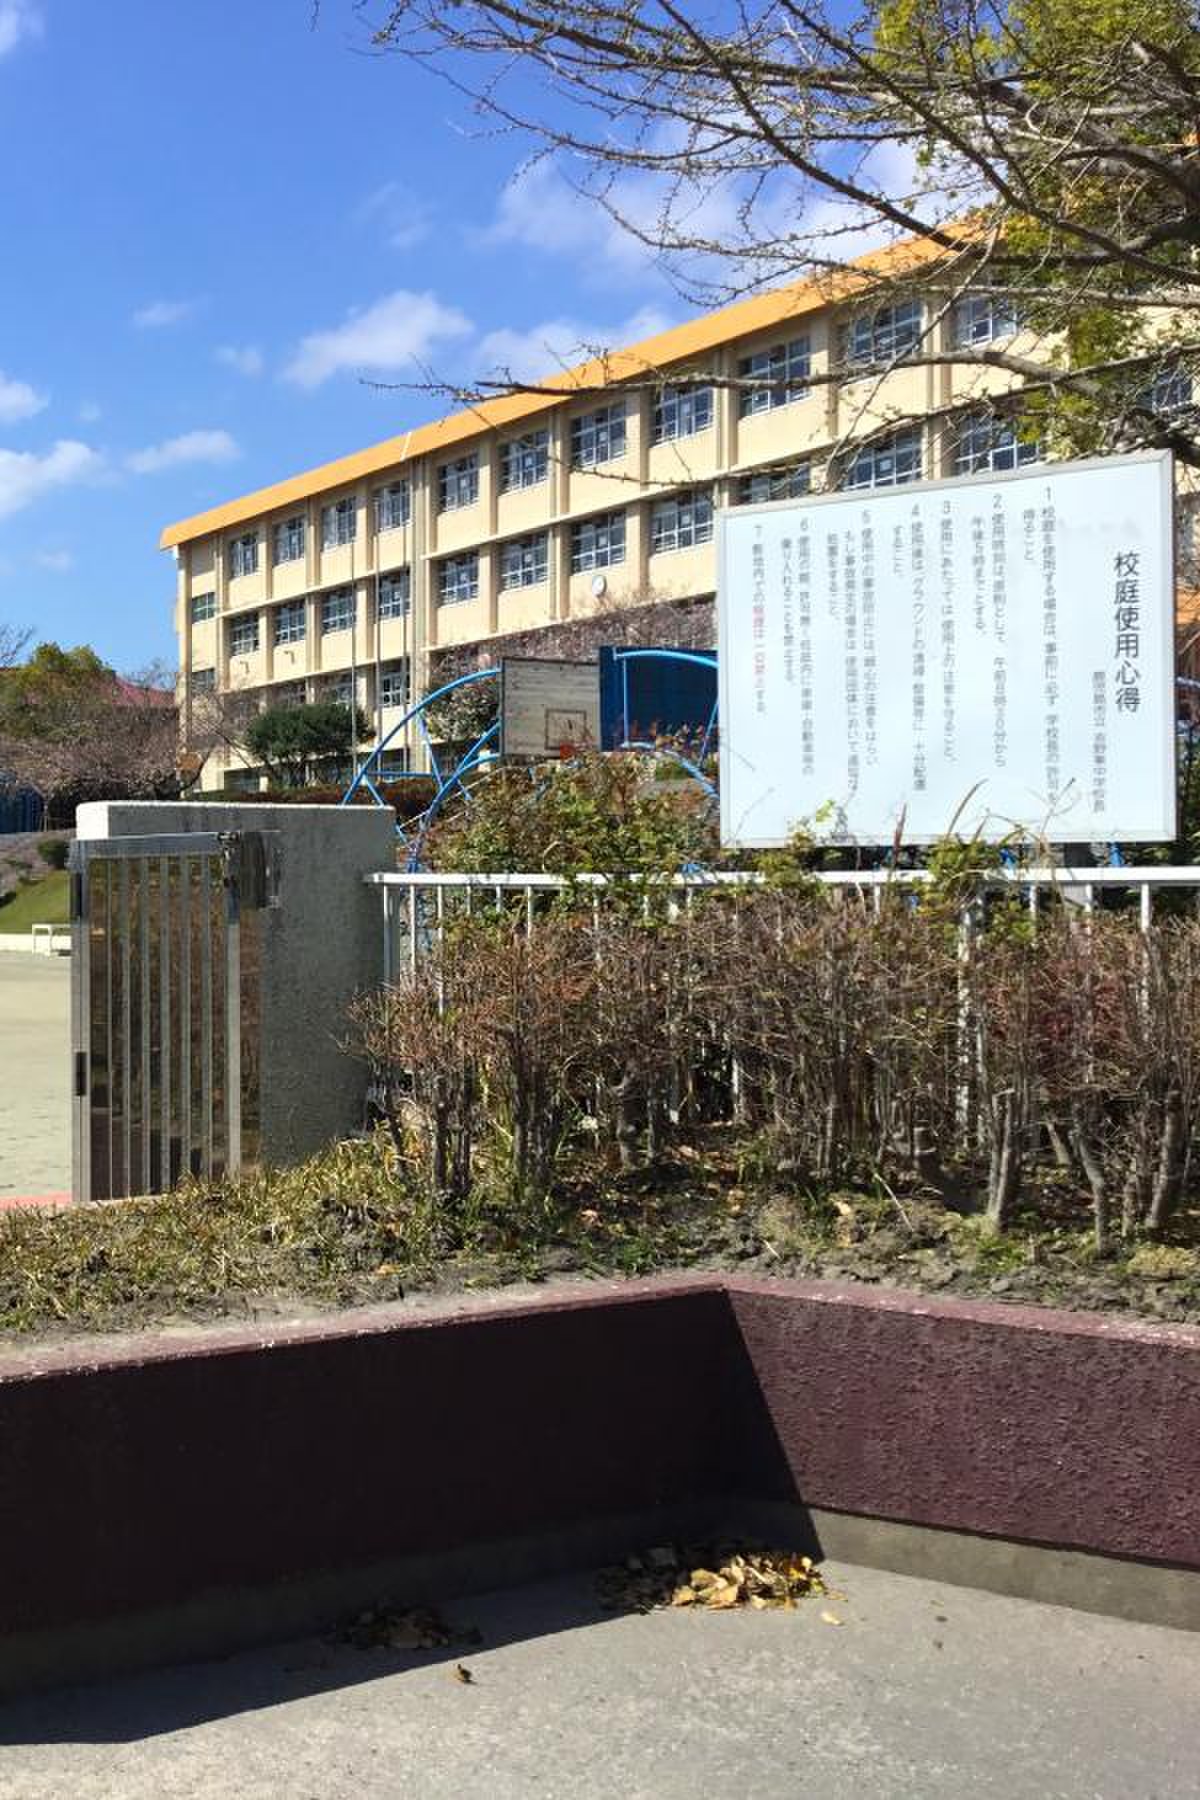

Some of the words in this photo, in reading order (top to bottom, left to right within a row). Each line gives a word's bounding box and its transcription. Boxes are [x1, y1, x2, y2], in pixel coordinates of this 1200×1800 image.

[1113, 549, 1142, 714] 校庭使用心得
